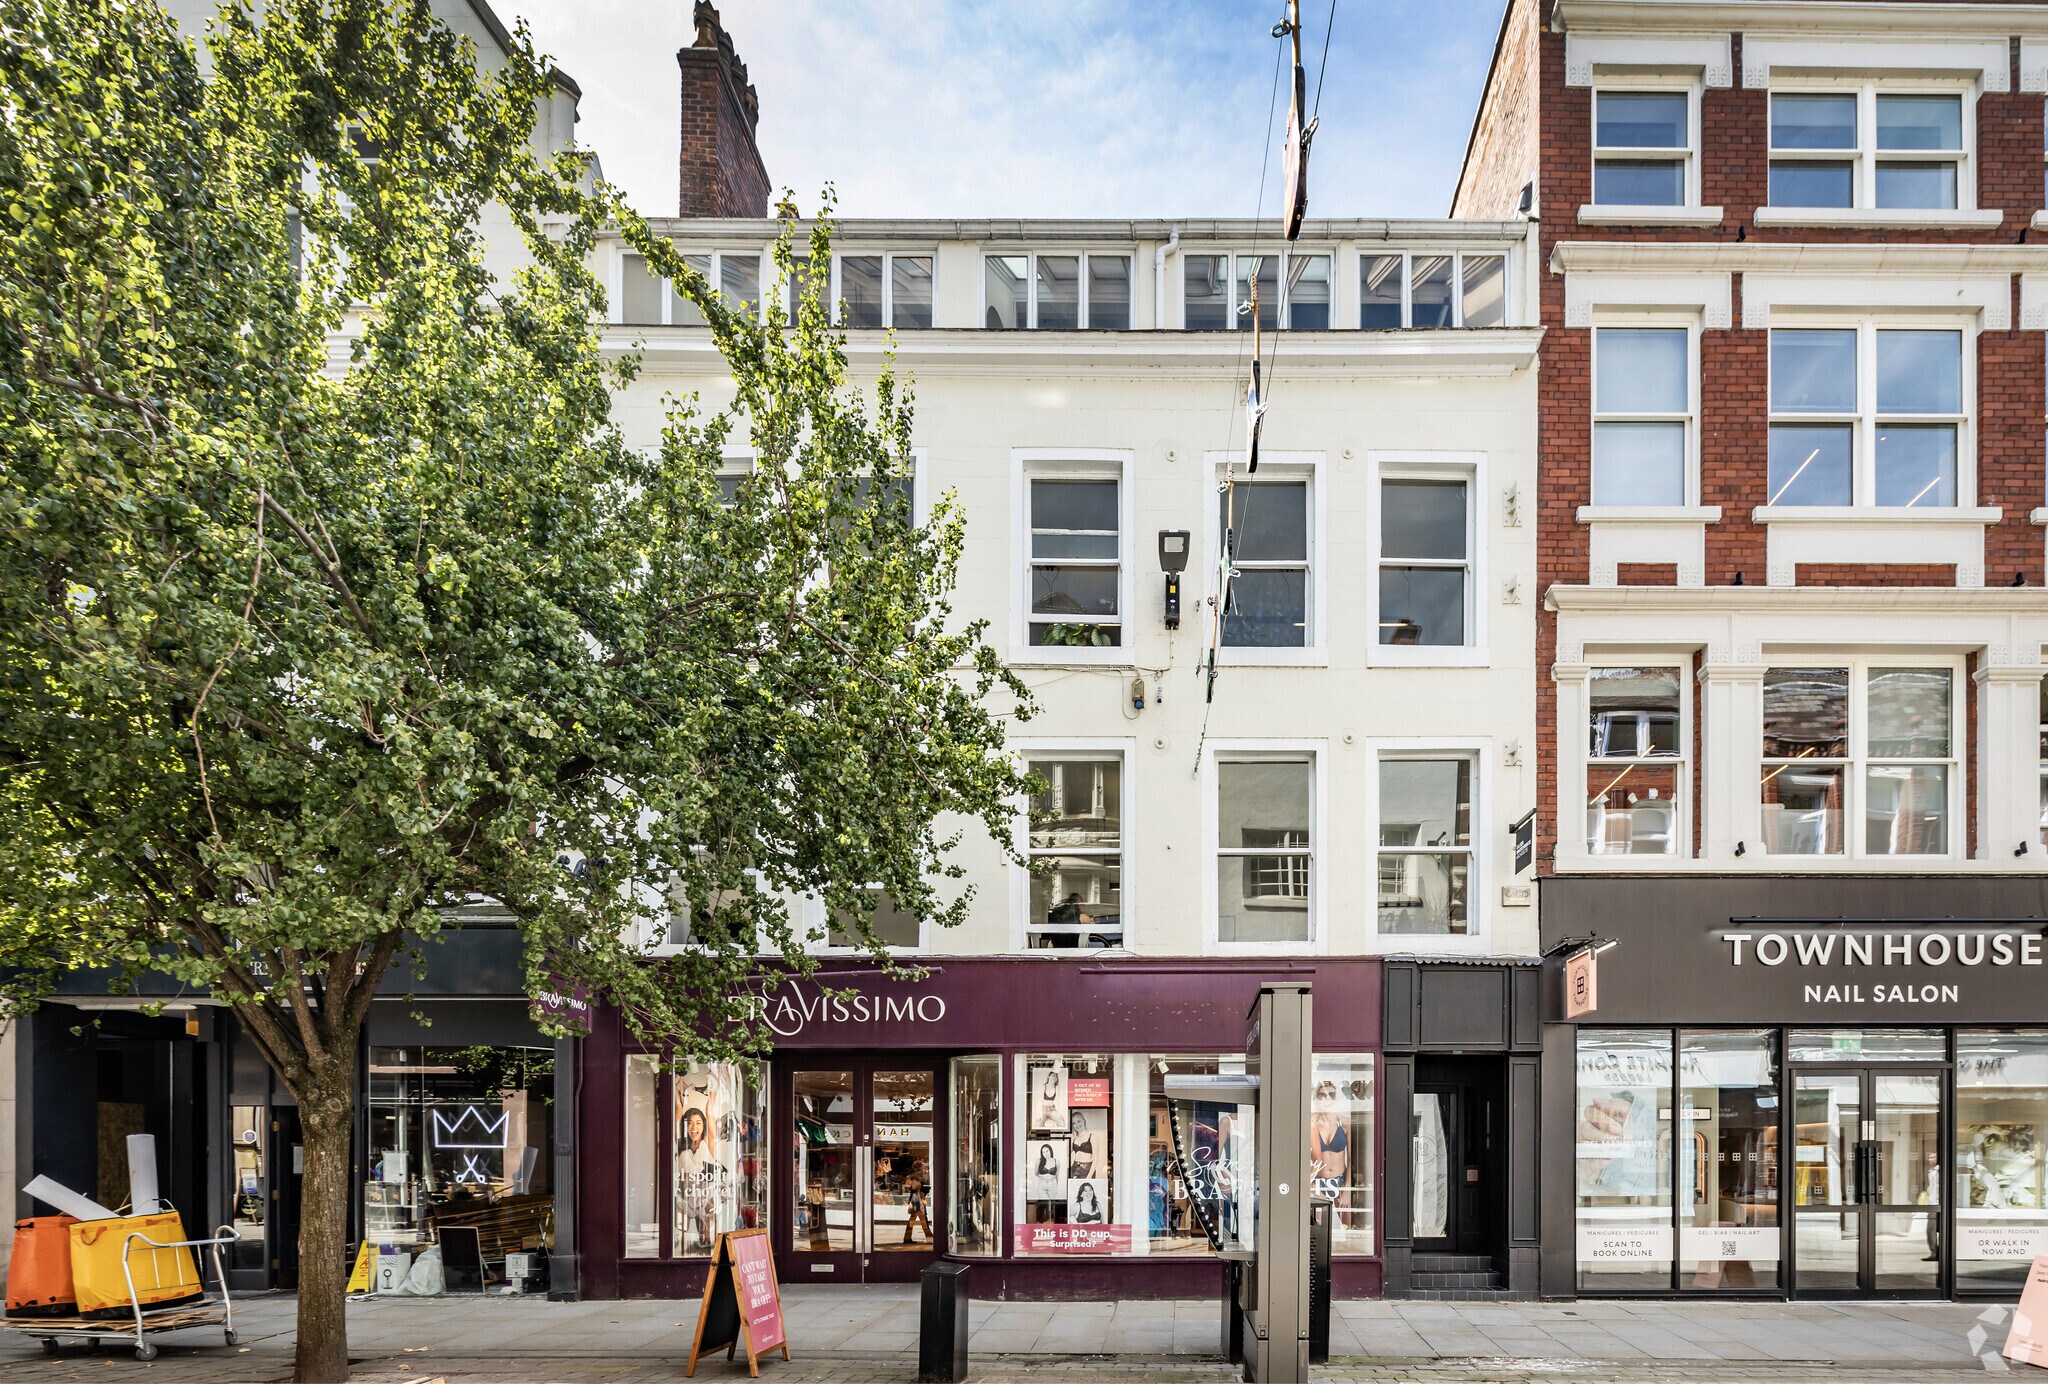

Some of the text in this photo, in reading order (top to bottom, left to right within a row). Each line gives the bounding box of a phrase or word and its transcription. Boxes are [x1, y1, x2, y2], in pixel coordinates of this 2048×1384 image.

[1723, 934, 2043, 966] TOWNHOUSE
[1804, 985, 1959, 1003] NAIL SALON
[1602, 1140, 1653, 1148] MANICURES
[1033, 1228, 1113, 1241] This is DD cup.
[1049, 1240, 1097, 1249] Surprised?
